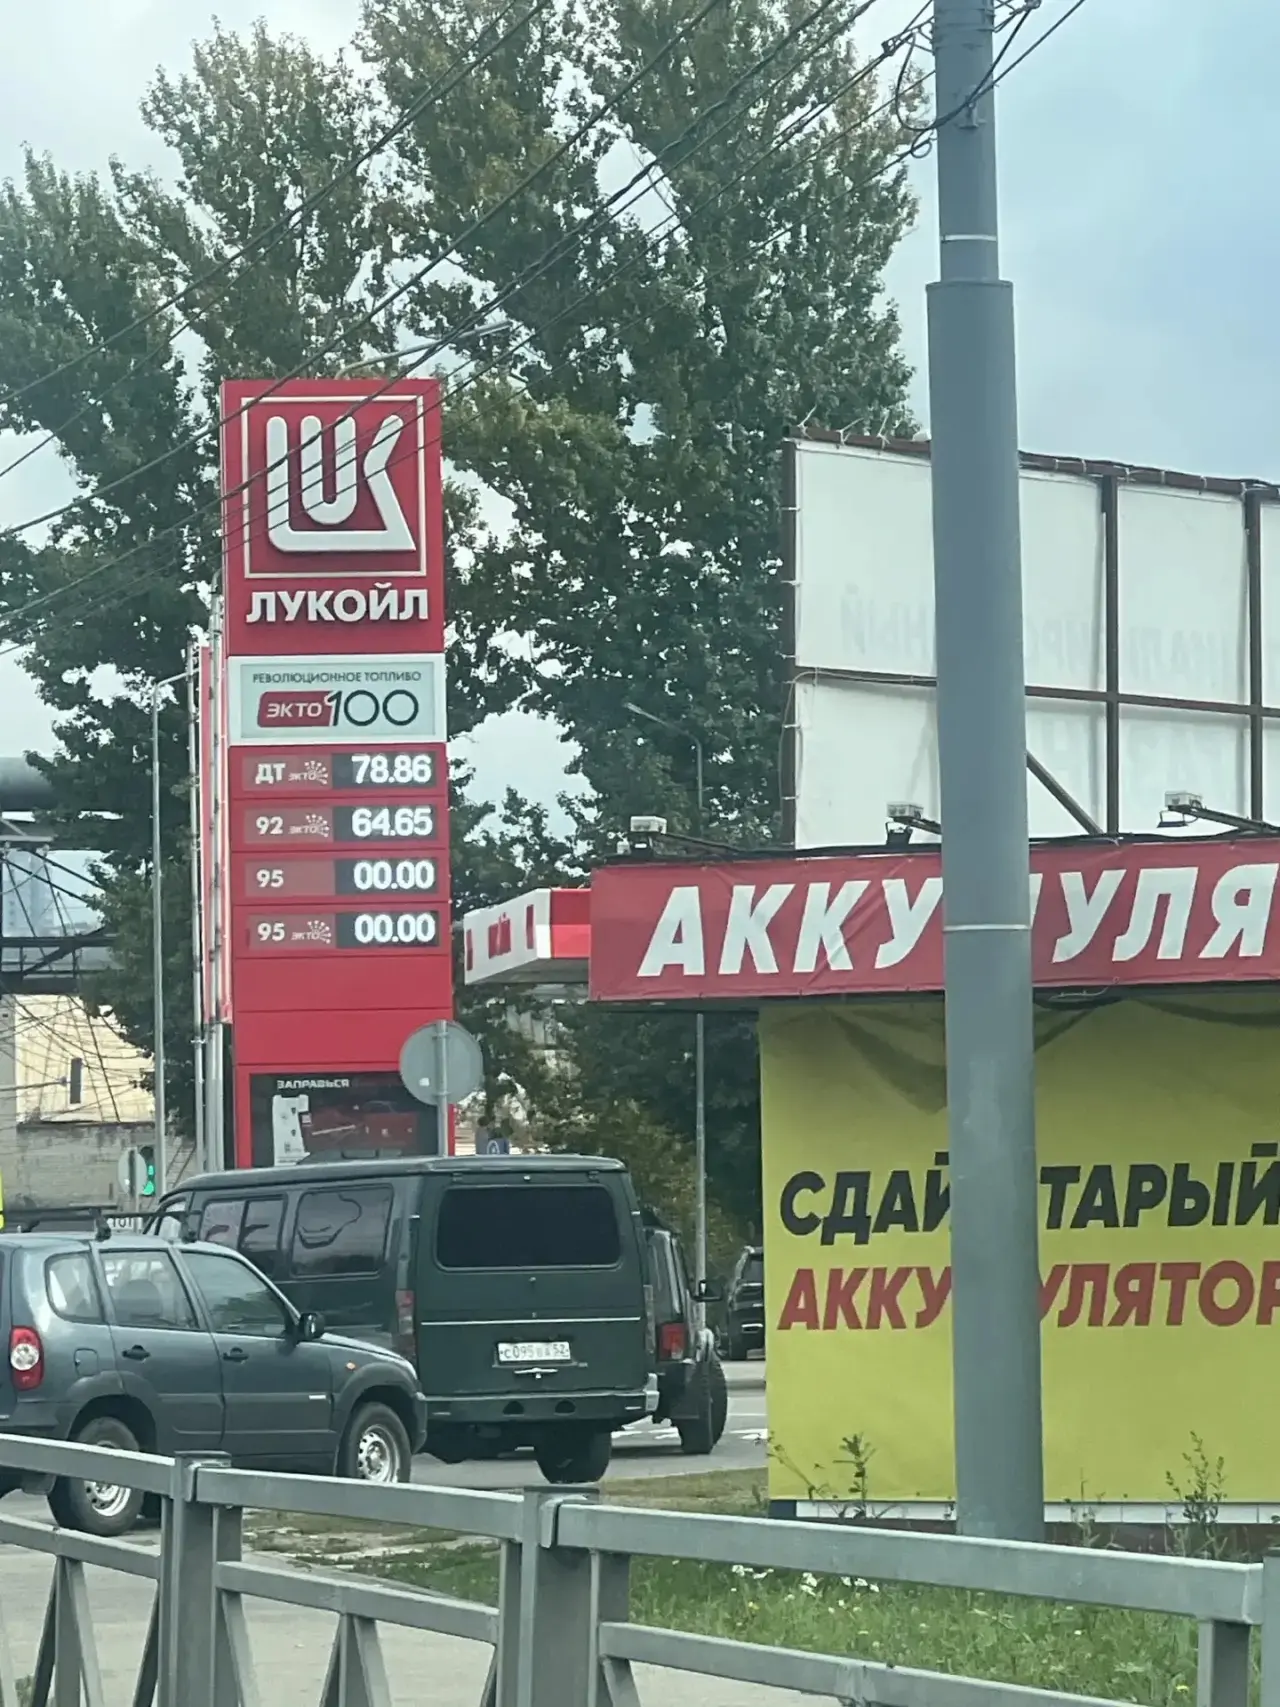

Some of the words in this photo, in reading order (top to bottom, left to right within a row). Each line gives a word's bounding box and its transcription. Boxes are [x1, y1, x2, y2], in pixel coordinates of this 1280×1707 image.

[246, 582, 429, 623] ЛУКОЙЛ
[252, 671, 362, 684] РЕВОЛЮЦИОННОЕ
[365, 671, 422, 683] ТОПЛИВО
[266, 702, 323, 719] ЭКТО
[327, 689, 419, 727] 100
[254, 763, 286, 785] ДТ
[351, 754, 432, 784] 78.86
[256, 816, 283, 835] 92
[351, 808, 433, 837] 64.65
[256, 870, 284, 887] 95
[353, 860, 435, 890] 00.00
[257, 923, 285, 941] 95
[354, 912, 436, 943] 00.00
[637, 862, 1280, 977] АККУУЛЯ
[1039, 1142, 1280, 1230] ТАРЫЙ
[777, 1259, 1280, 1331] АККУЛЯТОР
